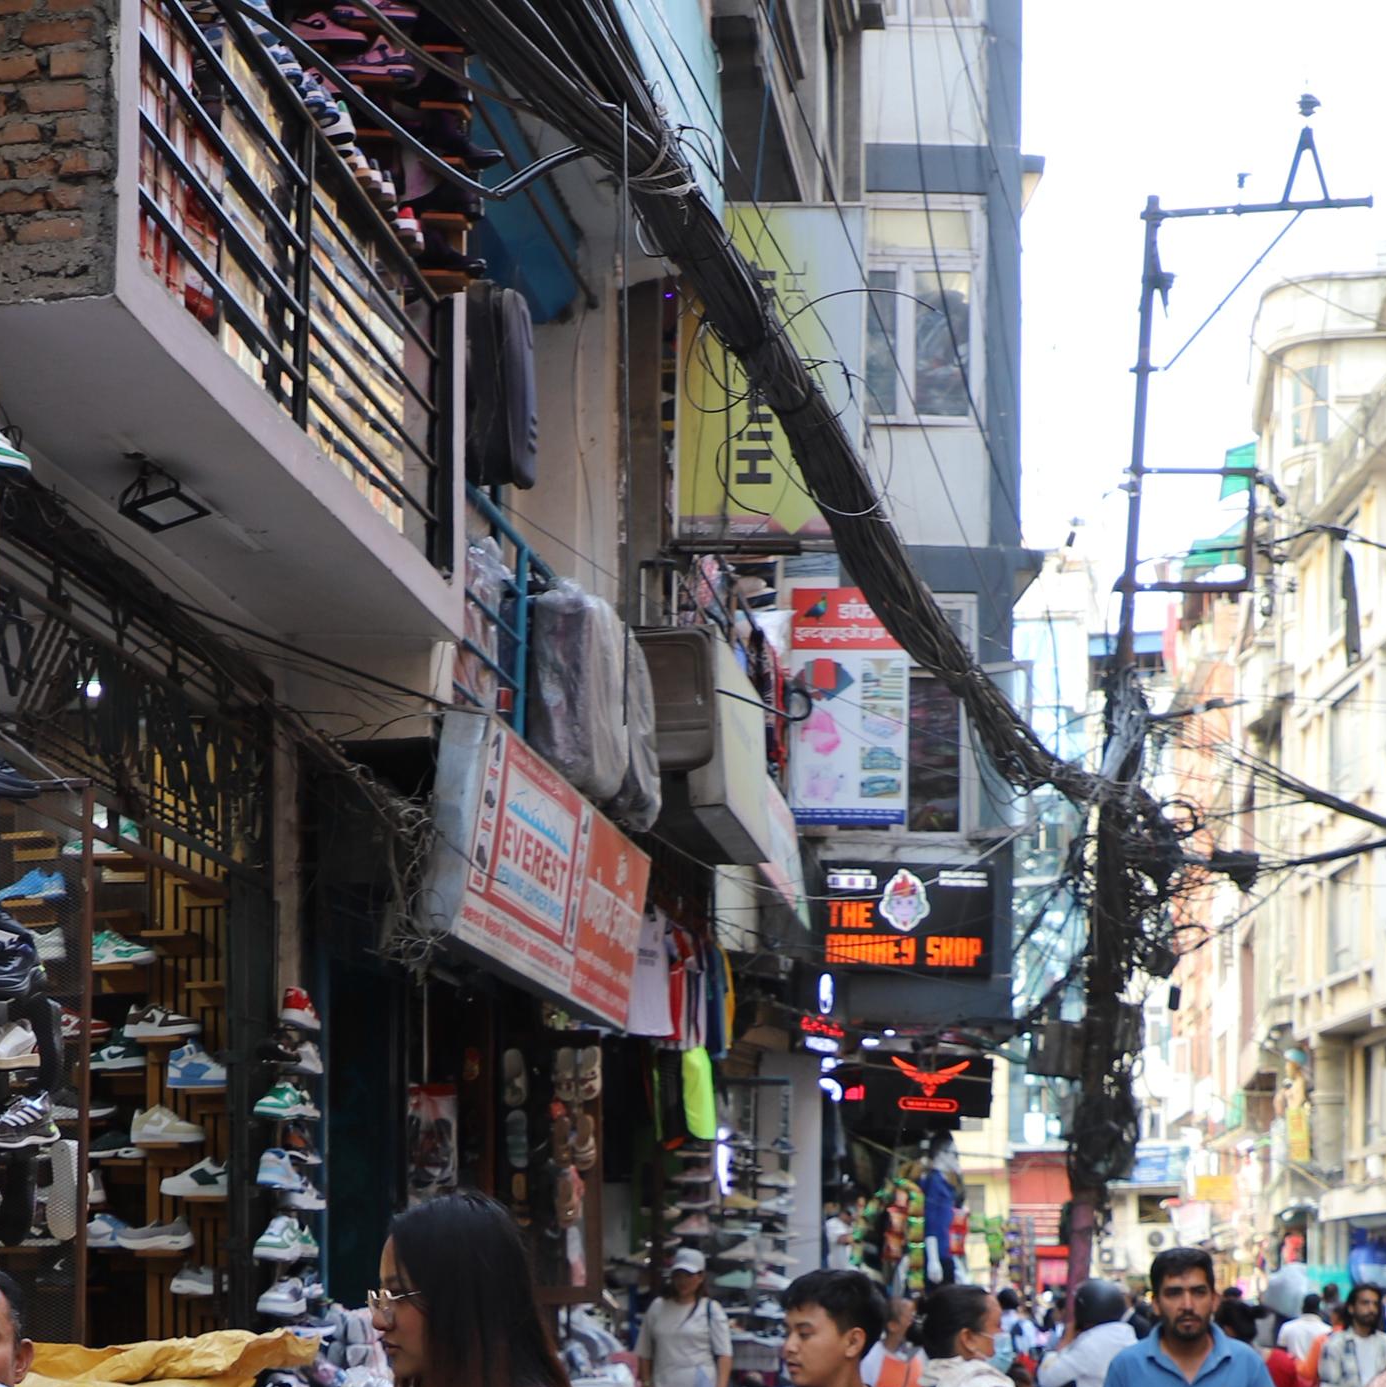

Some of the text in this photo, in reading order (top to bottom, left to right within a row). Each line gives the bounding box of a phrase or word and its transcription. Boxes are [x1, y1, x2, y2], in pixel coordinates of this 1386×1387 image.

[502, 815, 568, 897] EVEREST
[826, 901, 875, 928] THE
[925, 935, 983, 967] SHOP
